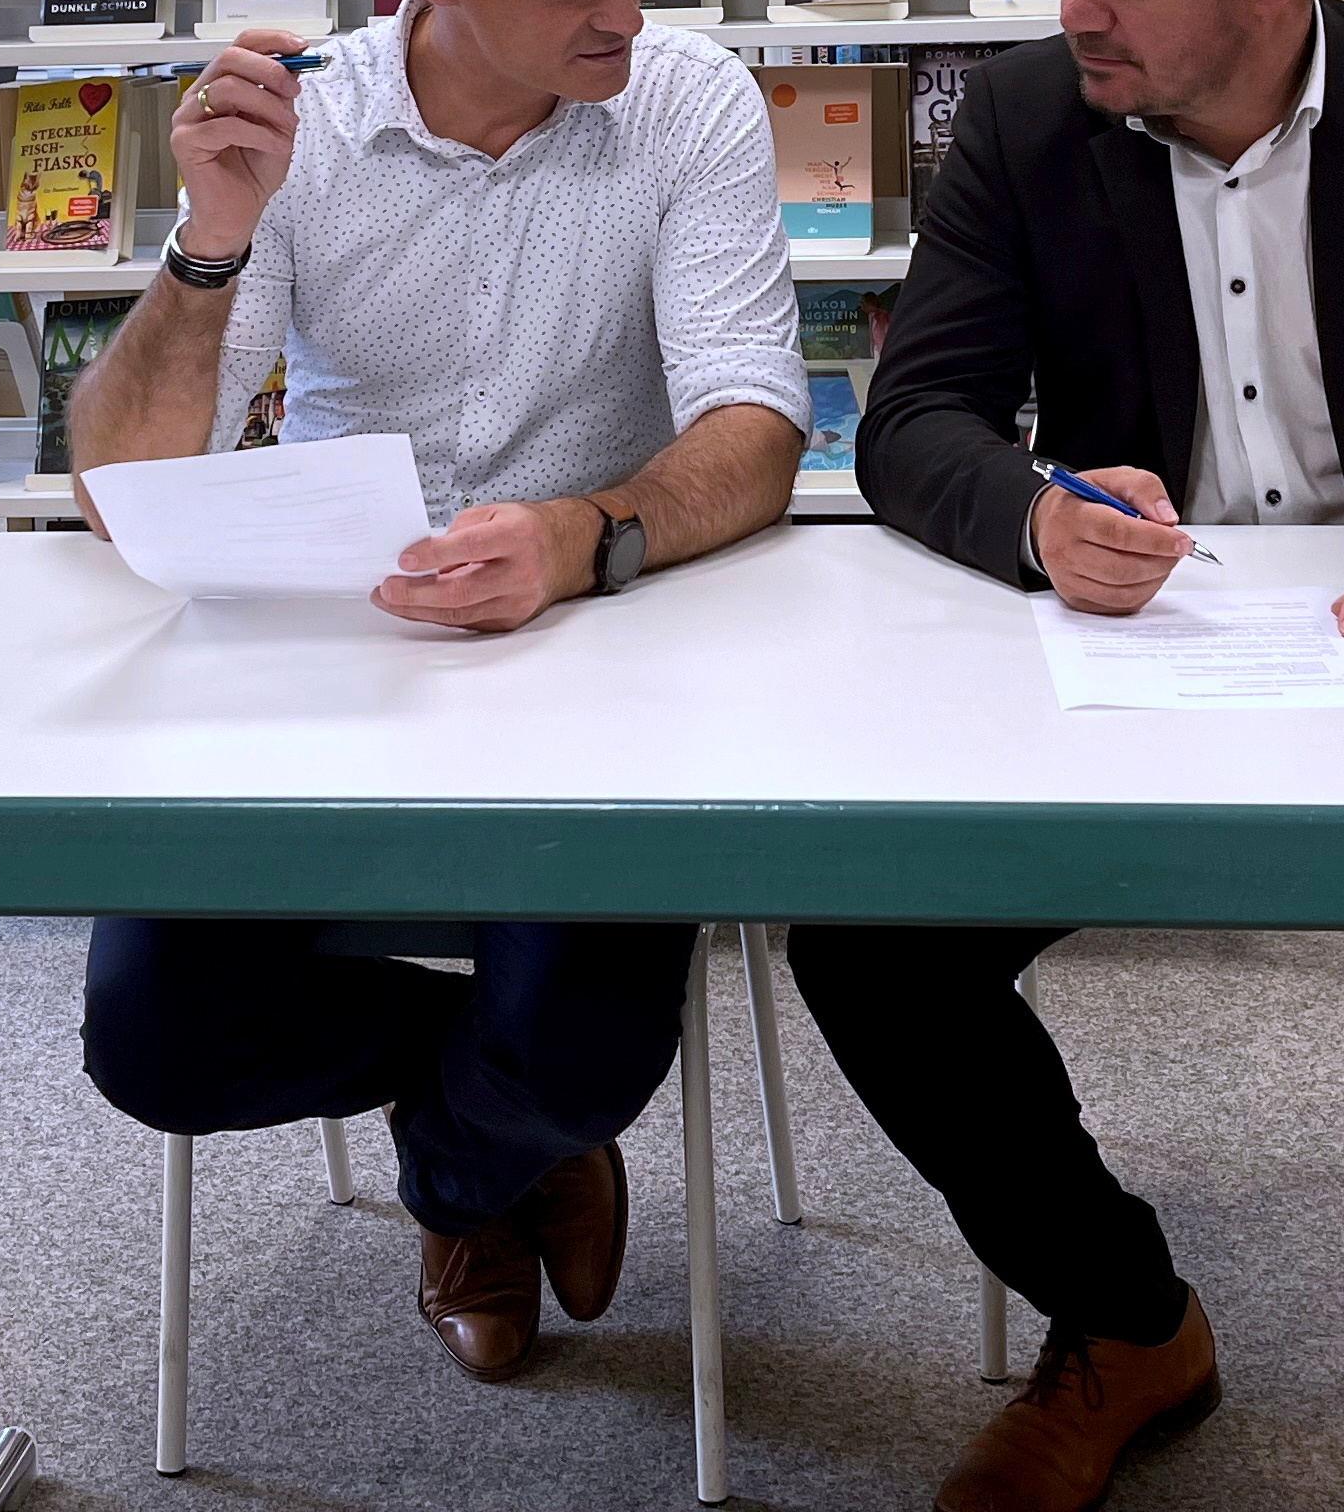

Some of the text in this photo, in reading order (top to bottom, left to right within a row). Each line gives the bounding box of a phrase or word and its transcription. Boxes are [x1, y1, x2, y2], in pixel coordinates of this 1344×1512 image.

[51, 0, 147, 13] DUNKLE SCHULD
[925, 50, 965, 59] ROMY
[22, 97, 72, 114] Rita Falk
[31, 125, 106, 141] STECKERL-
[20, 142, 64, 156] FISCH-
[33, 153, 97, 172] FIASKO
[807, 300, 847, 310] JAKOB
[799, 323, 857, 334] Strömung
